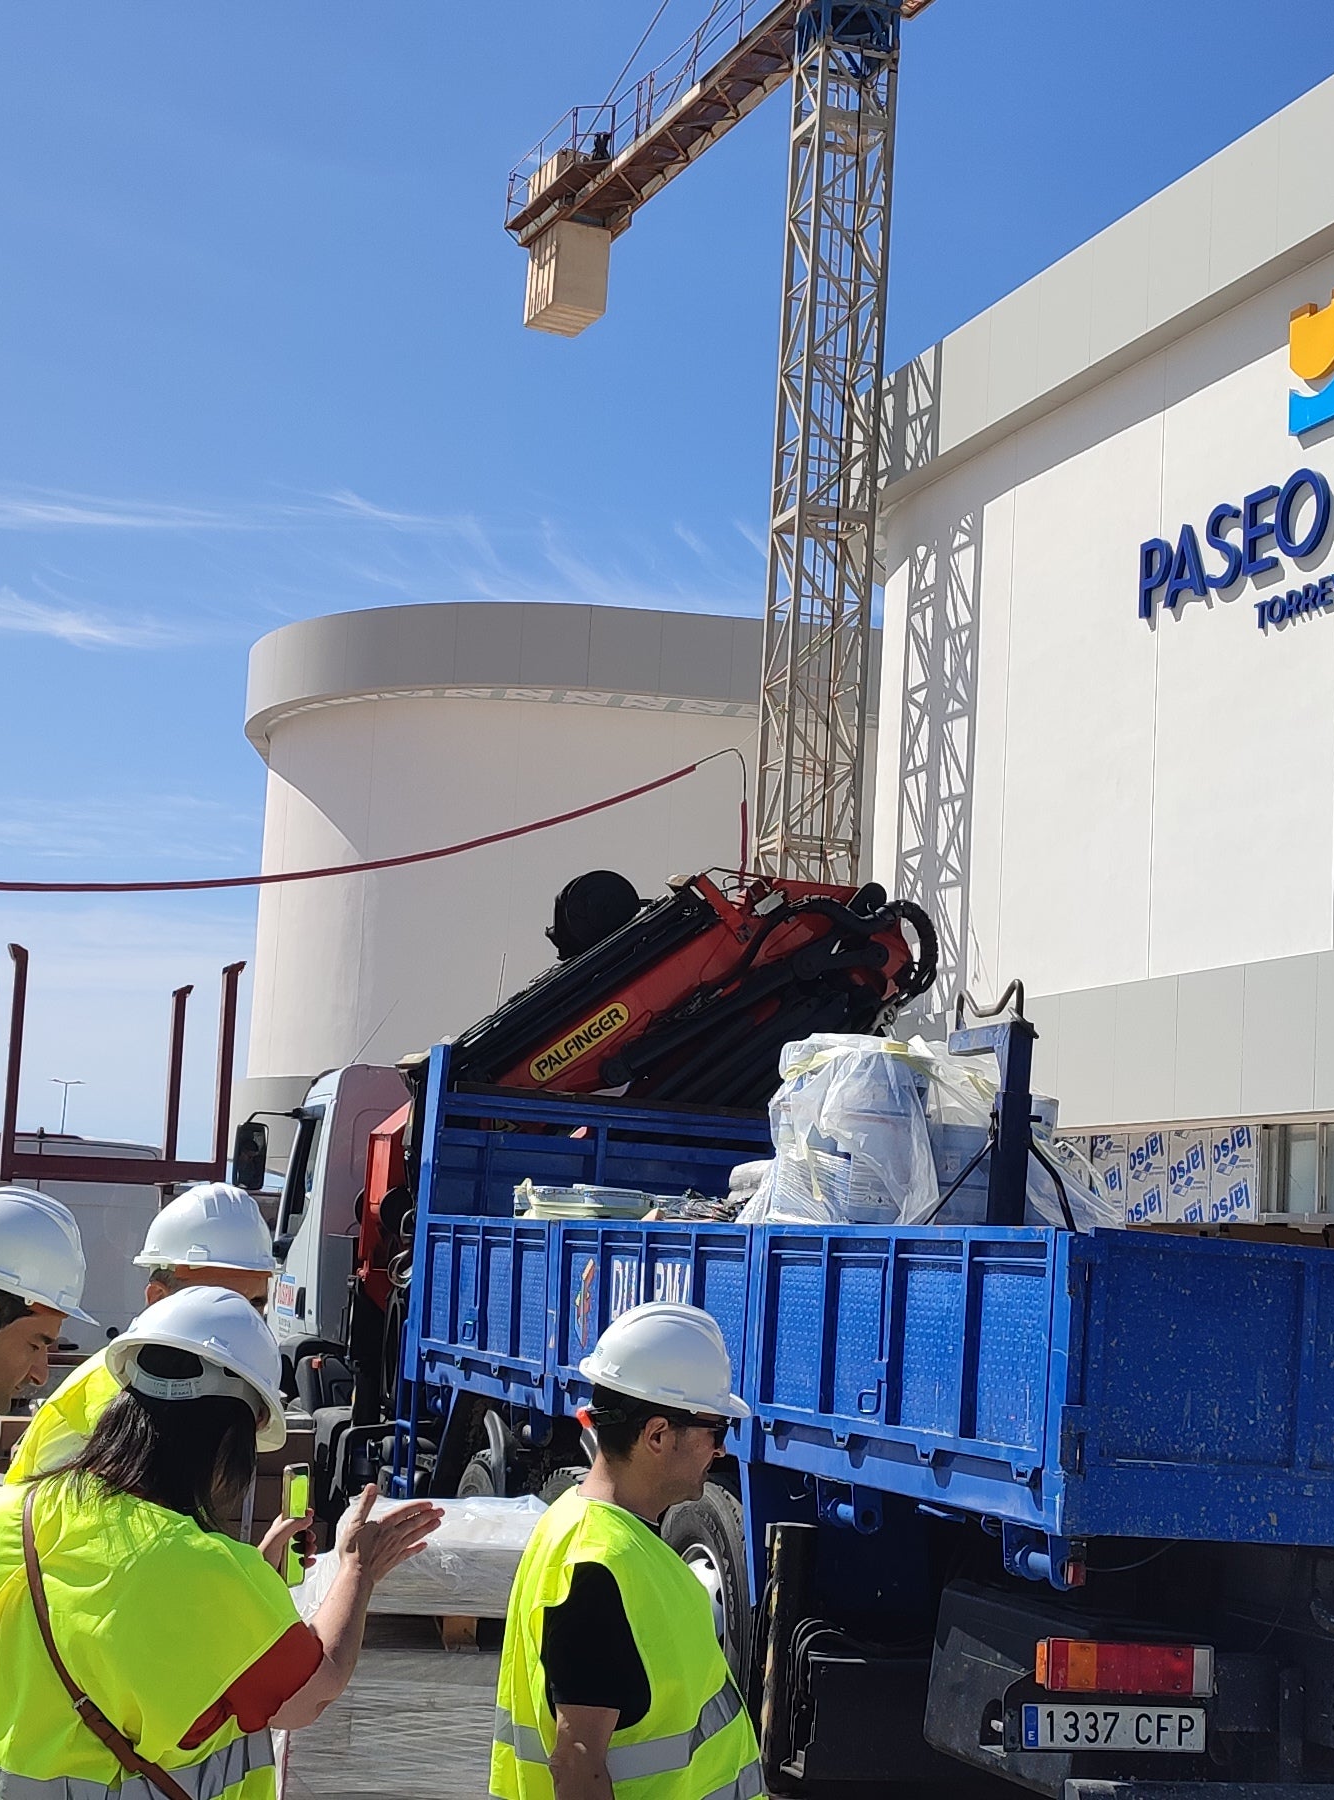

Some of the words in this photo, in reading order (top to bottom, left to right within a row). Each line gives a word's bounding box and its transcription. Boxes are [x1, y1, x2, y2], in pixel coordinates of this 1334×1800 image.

[1139, 467, 1330, 619] PASEO
[534, 1007, 625, 1078] PALFINGER
[1046, 1710, 1120, 1744] 1337
[1135, 1713, 1195, 1747] CFP
